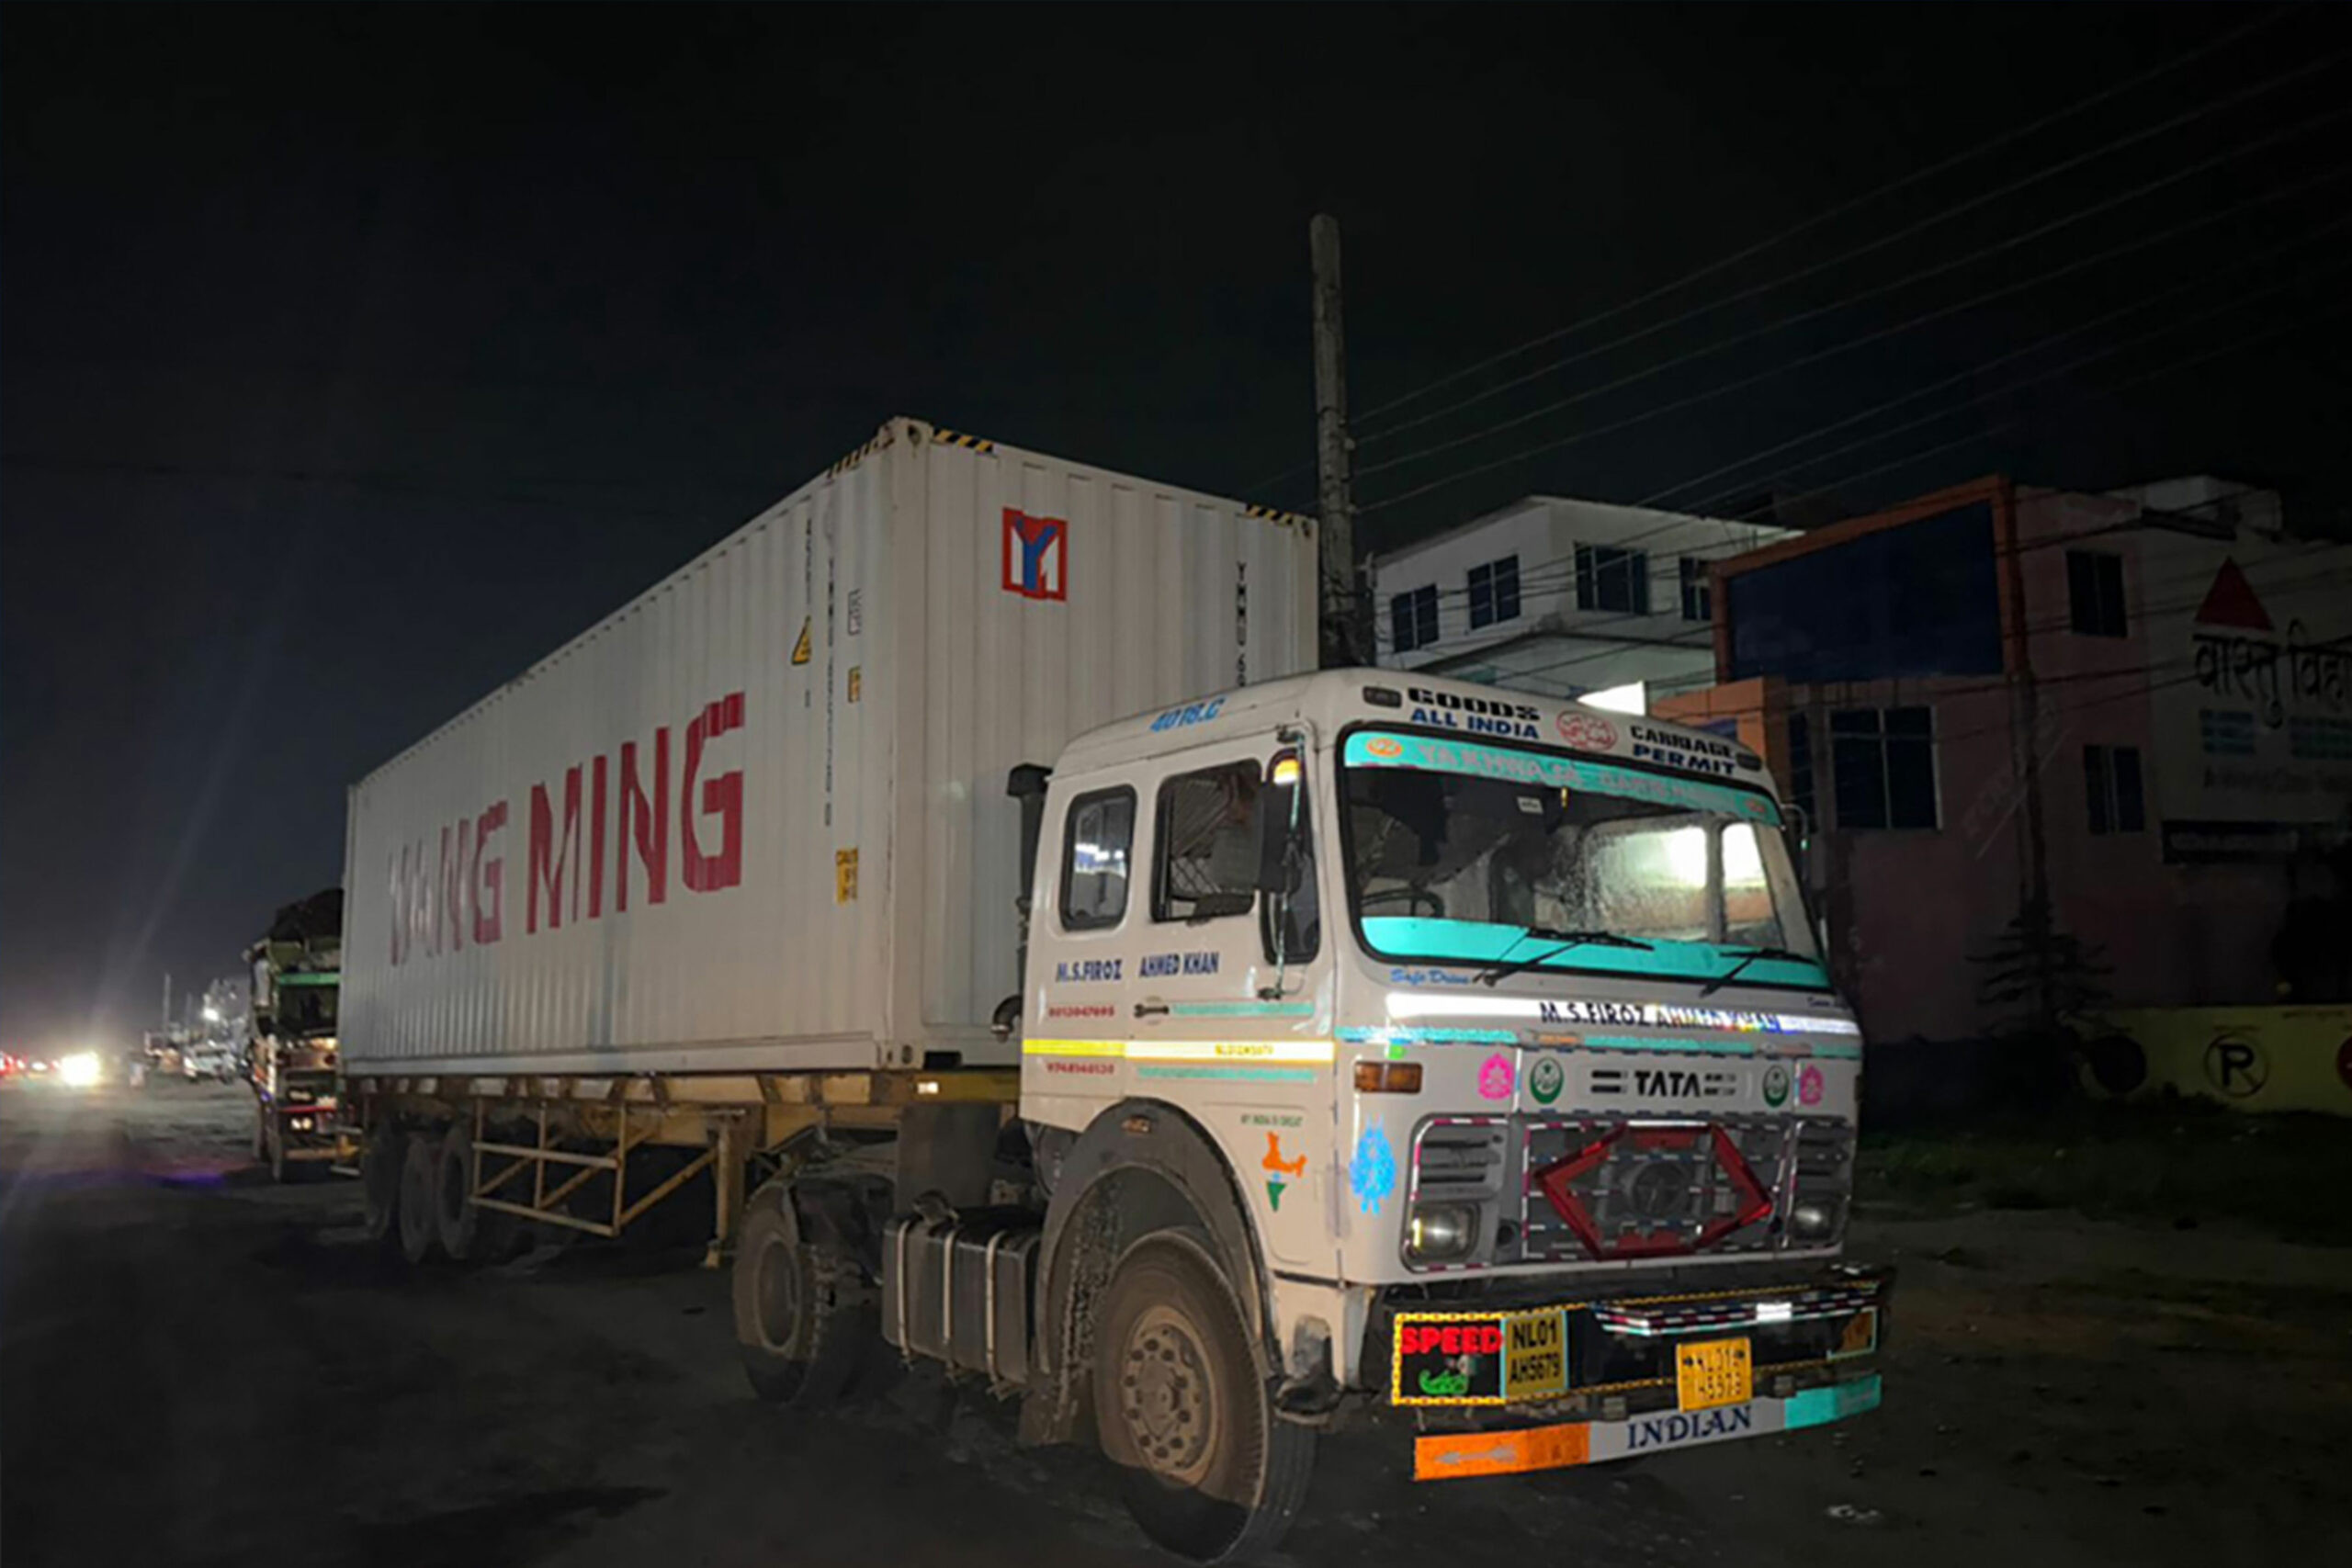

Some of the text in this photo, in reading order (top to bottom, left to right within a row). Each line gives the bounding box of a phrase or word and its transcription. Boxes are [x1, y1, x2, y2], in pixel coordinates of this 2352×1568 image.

[1408, 687, 1541, 721] GOODS
[1411, 707, 1457, 728] ALL
[1467, 715, 1541, 739] INDIA
[1630, 725, 1736, 760] CARRIAGE
[1633, 743, 1736, 774] PERMIT
[390, 800, 508, 966] YANG
[526, 692, 745, 934] MING
[1056, 952, 1219, 982] M.S.FIROZ AHMED KHAN
[1540, 1001, 1649, 1028] M.S.FIROZ
[1634, 1070, 1701, 1098] TATA
[1401, 1325, 1503, 1355] SPEED
[1511, 1319, 1558, 1350] NL01
[1626, 1405, 1752, 1450] INDIAN
